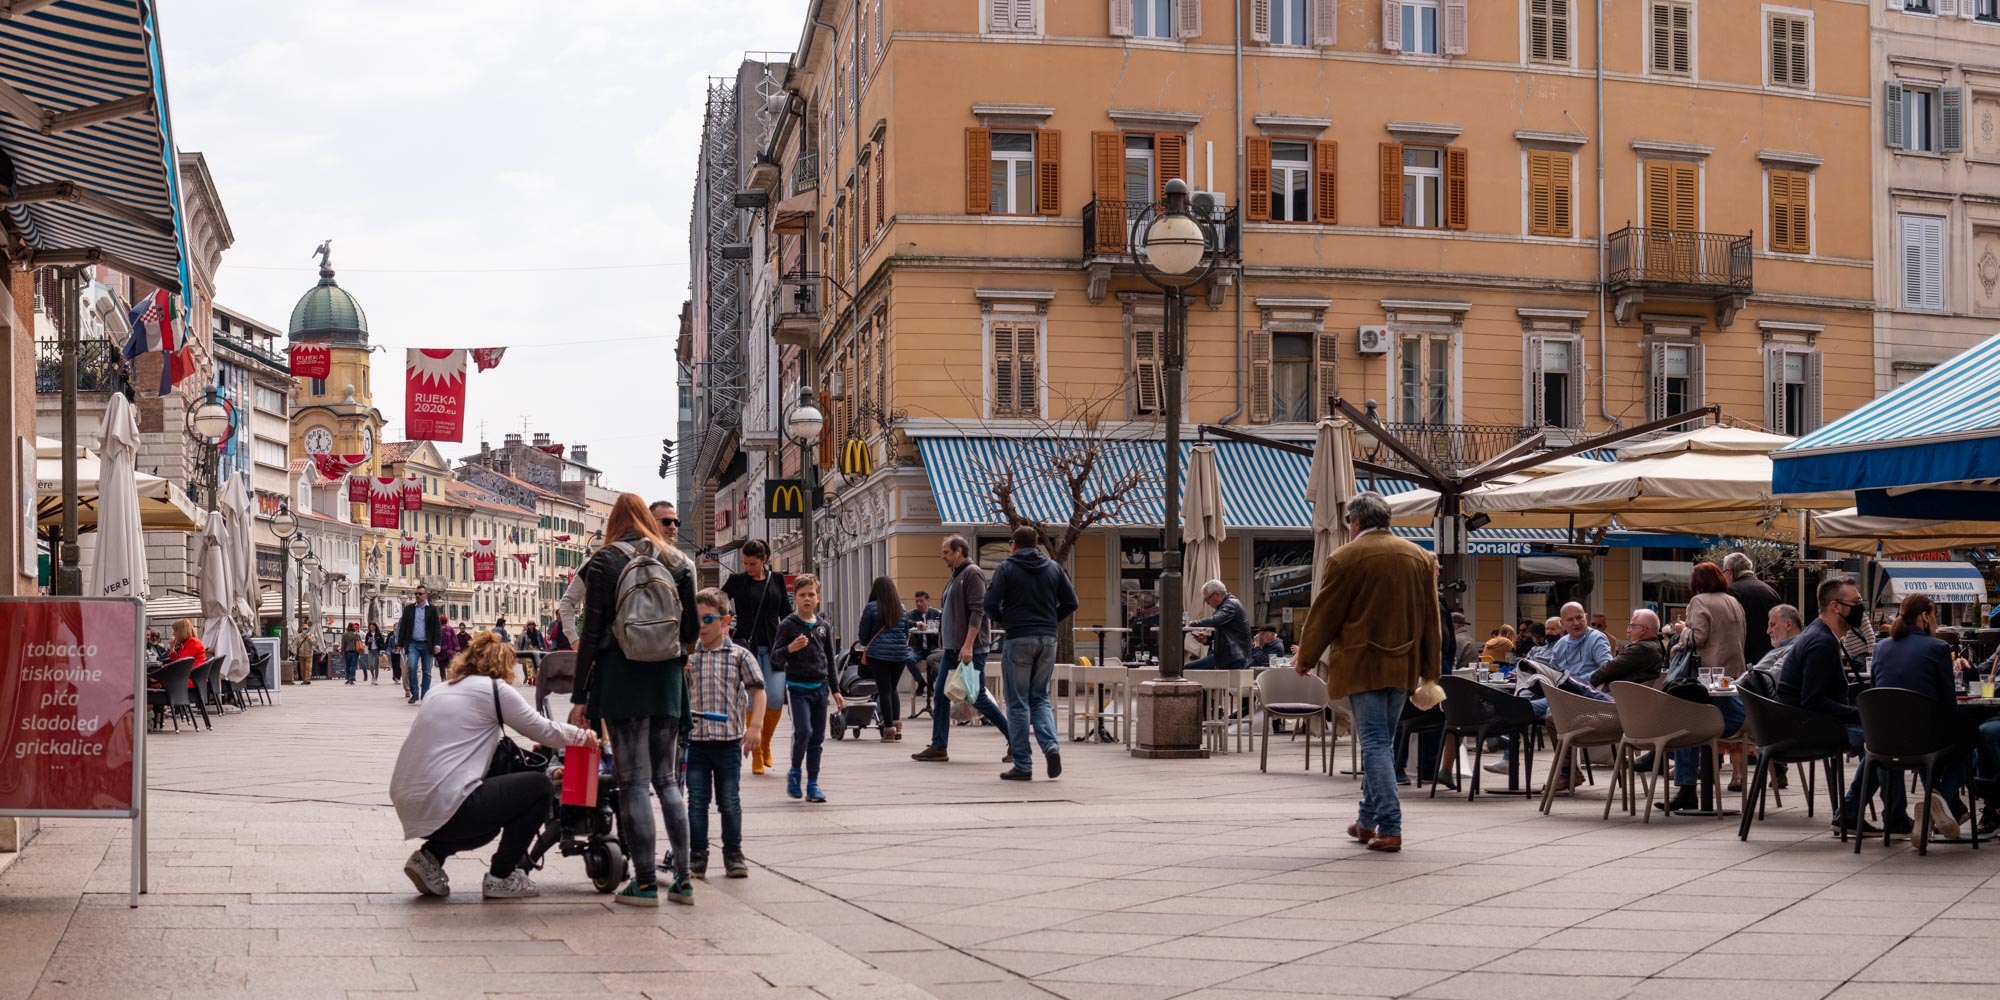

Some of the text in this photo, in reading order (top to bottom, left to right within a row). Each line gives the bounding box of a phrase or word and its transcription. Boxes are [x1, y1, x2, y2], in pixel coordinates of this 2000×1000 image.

[415, 392, 457, 406] RIJEKA
[414, 403, 457, 415] 2020.eu
[37, 481, 53, 489] ère
[1468, 542, 1532, 554] Donald's
[1934, 581, 1974, 590] KOPIRNICA
[27, 641, 98, 657] tobacco
[21, 666, 103, 682] tiskovine
[41, 687, 80, 709] pića
[21, 714, 99, 731] sladoled
[15, 739, 103, 759] grickalice
